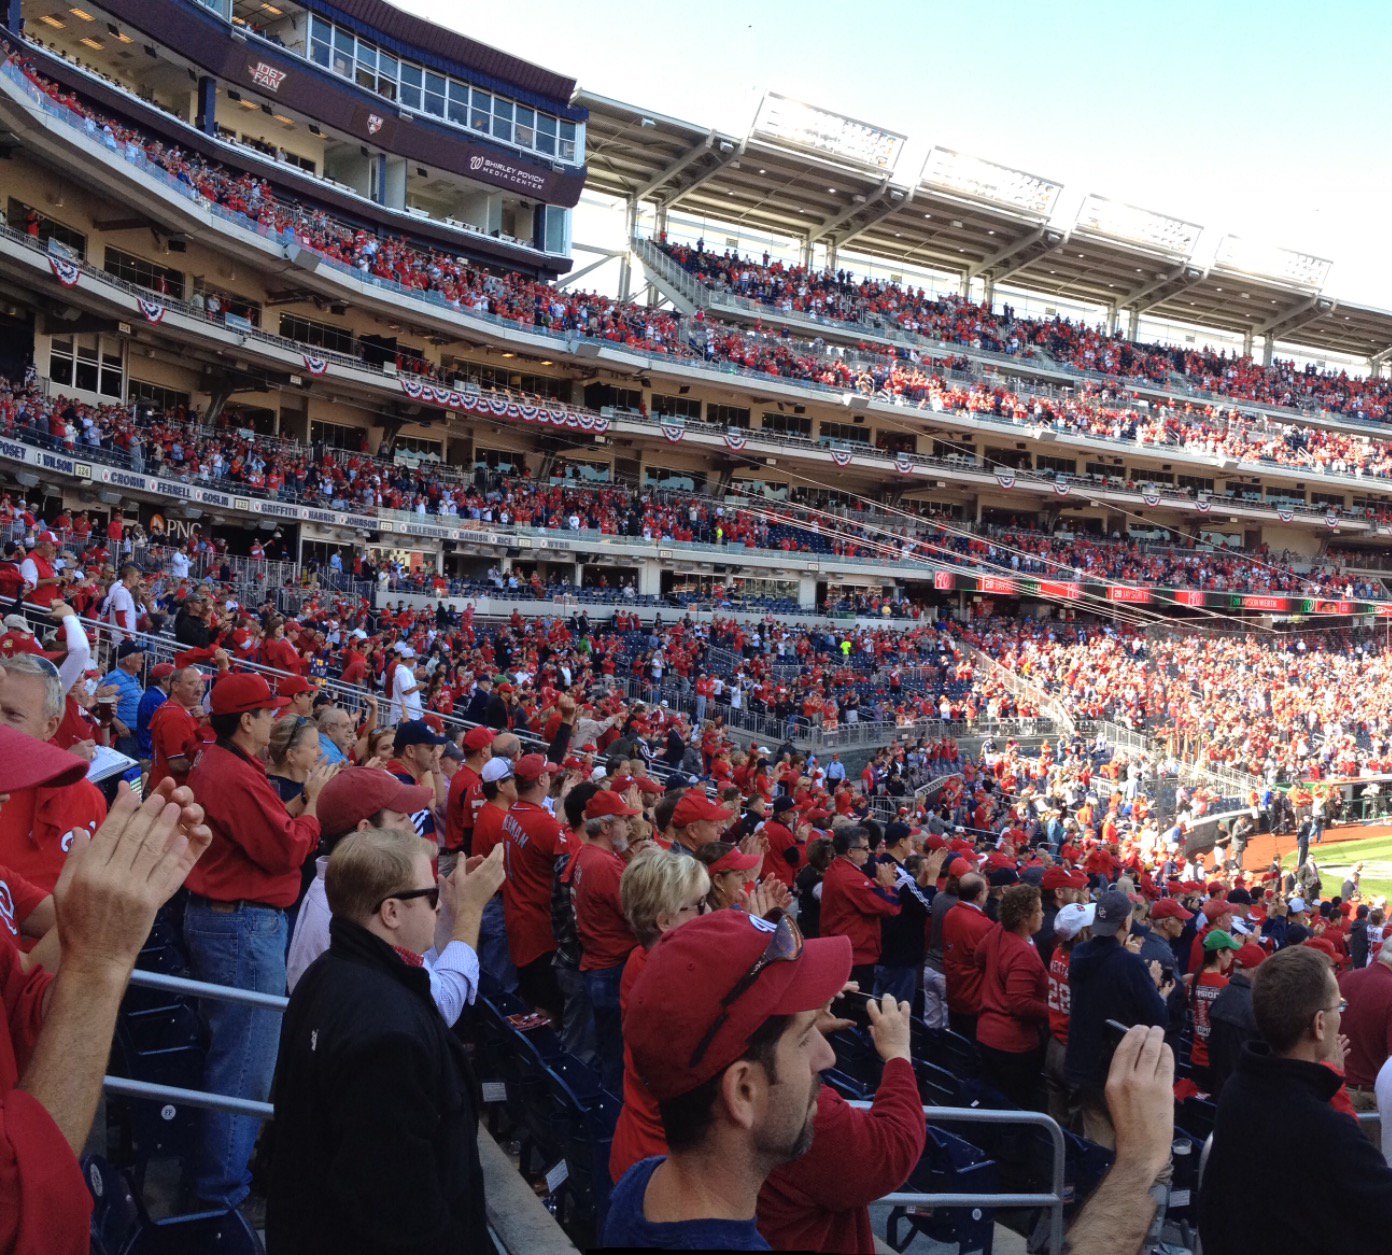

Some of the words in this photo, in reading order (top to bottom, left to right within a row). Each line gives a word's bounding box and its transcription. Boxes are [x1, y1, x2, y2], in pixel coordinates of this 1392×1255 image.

[253, 71, 281, 89] FAN
[482, 166, 508, 179] MEDIA
[510, 176, 543, 190] CENTER
[484, 159, 517, 175] SHIRLEY
[517, 170, 545, 184] POVICH
[42, 453, 73, 474] WILSON
[110, 472, 146, 489] CRONIN
[157, 482, 192, 499] FERRELL
[202, 492, 229, 507] GOSLIN
[261, 503, 299, 518] GRIFFITH
[308, 510, 336, 523] HARRIS
[166, 518, 202, 540] PNC
[345, 516, 378, 529] JOHNSON
[1047, 976, 1071, 1016] 28
